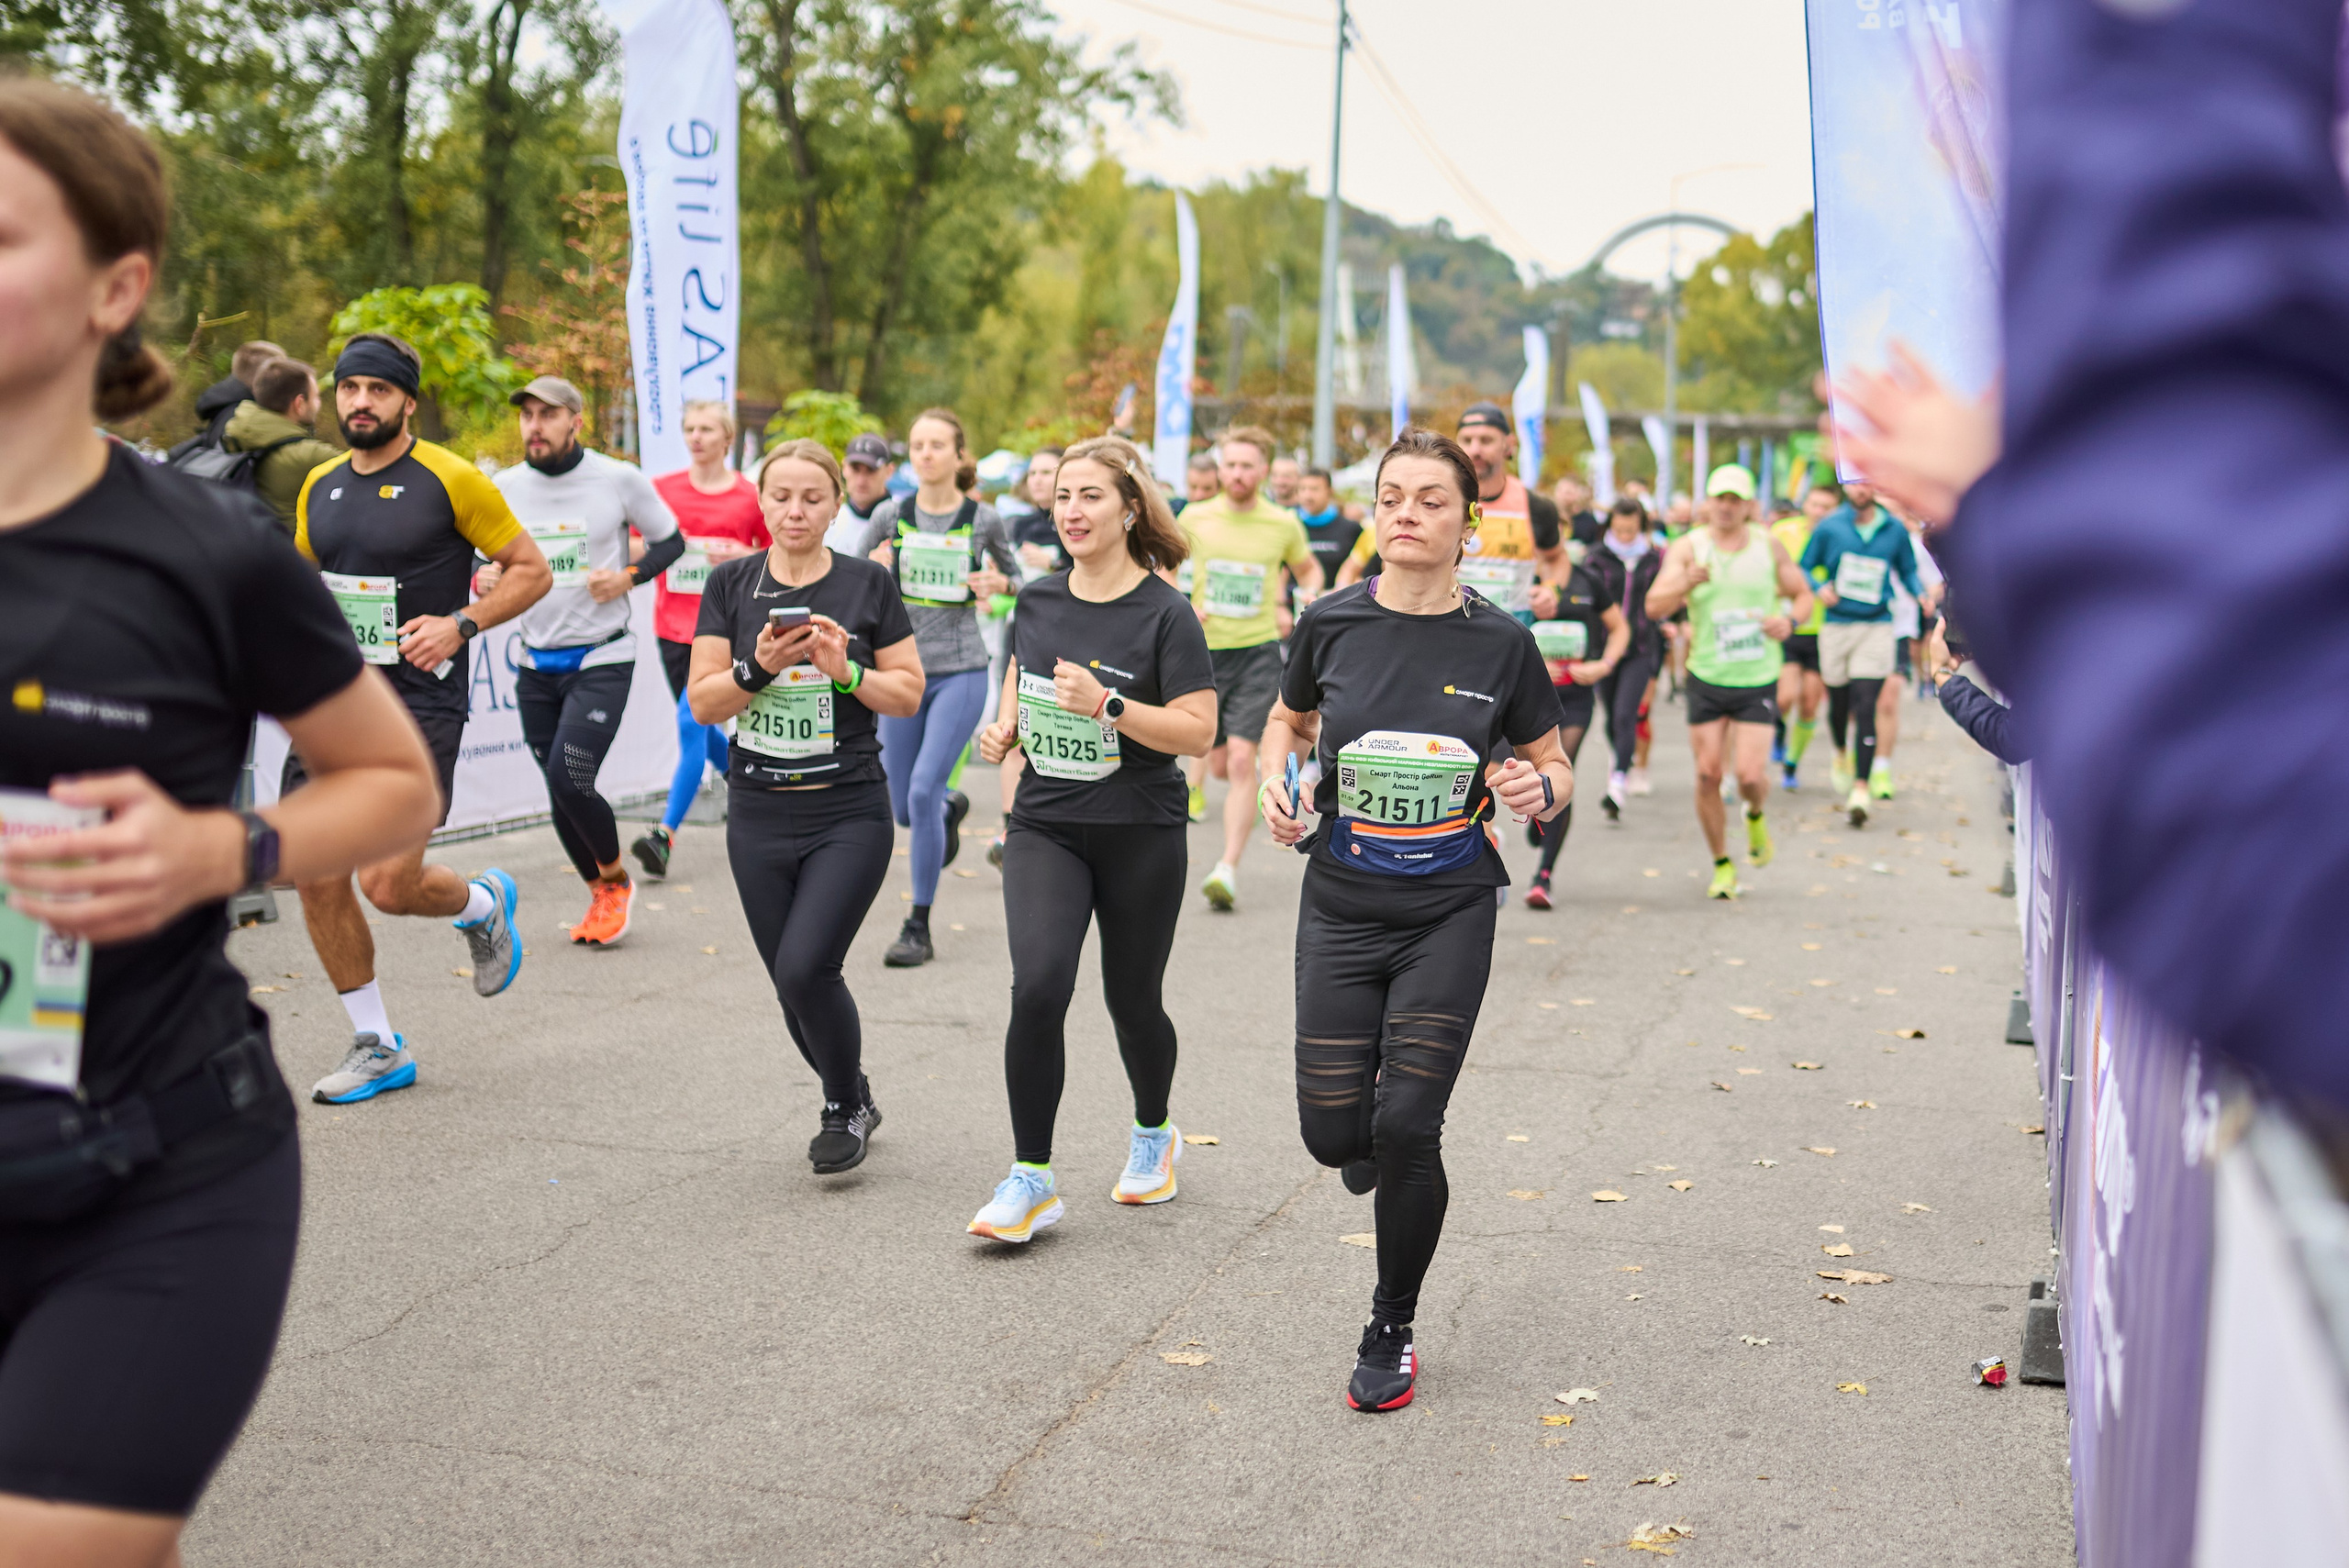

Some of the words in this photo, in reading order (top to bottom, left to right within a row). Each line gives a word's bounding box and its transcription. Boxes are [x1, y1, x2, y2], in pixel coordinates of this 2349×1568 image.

[908, 568, 953, 586] 21311
[750, 710, 812, 740] 21510
[1031, 731, 1097, 762] 21525
[1428, 742, 1469, 755] АВРОРА
[1369, 769, 1392, 779] Смарт
[1393, 771, 1419, 782] Простір
[1421, 773, 1443, 781] GoRun
[1391, 783, 1419, 791] Альона
[1356, 789, 1441, 824] 21511
